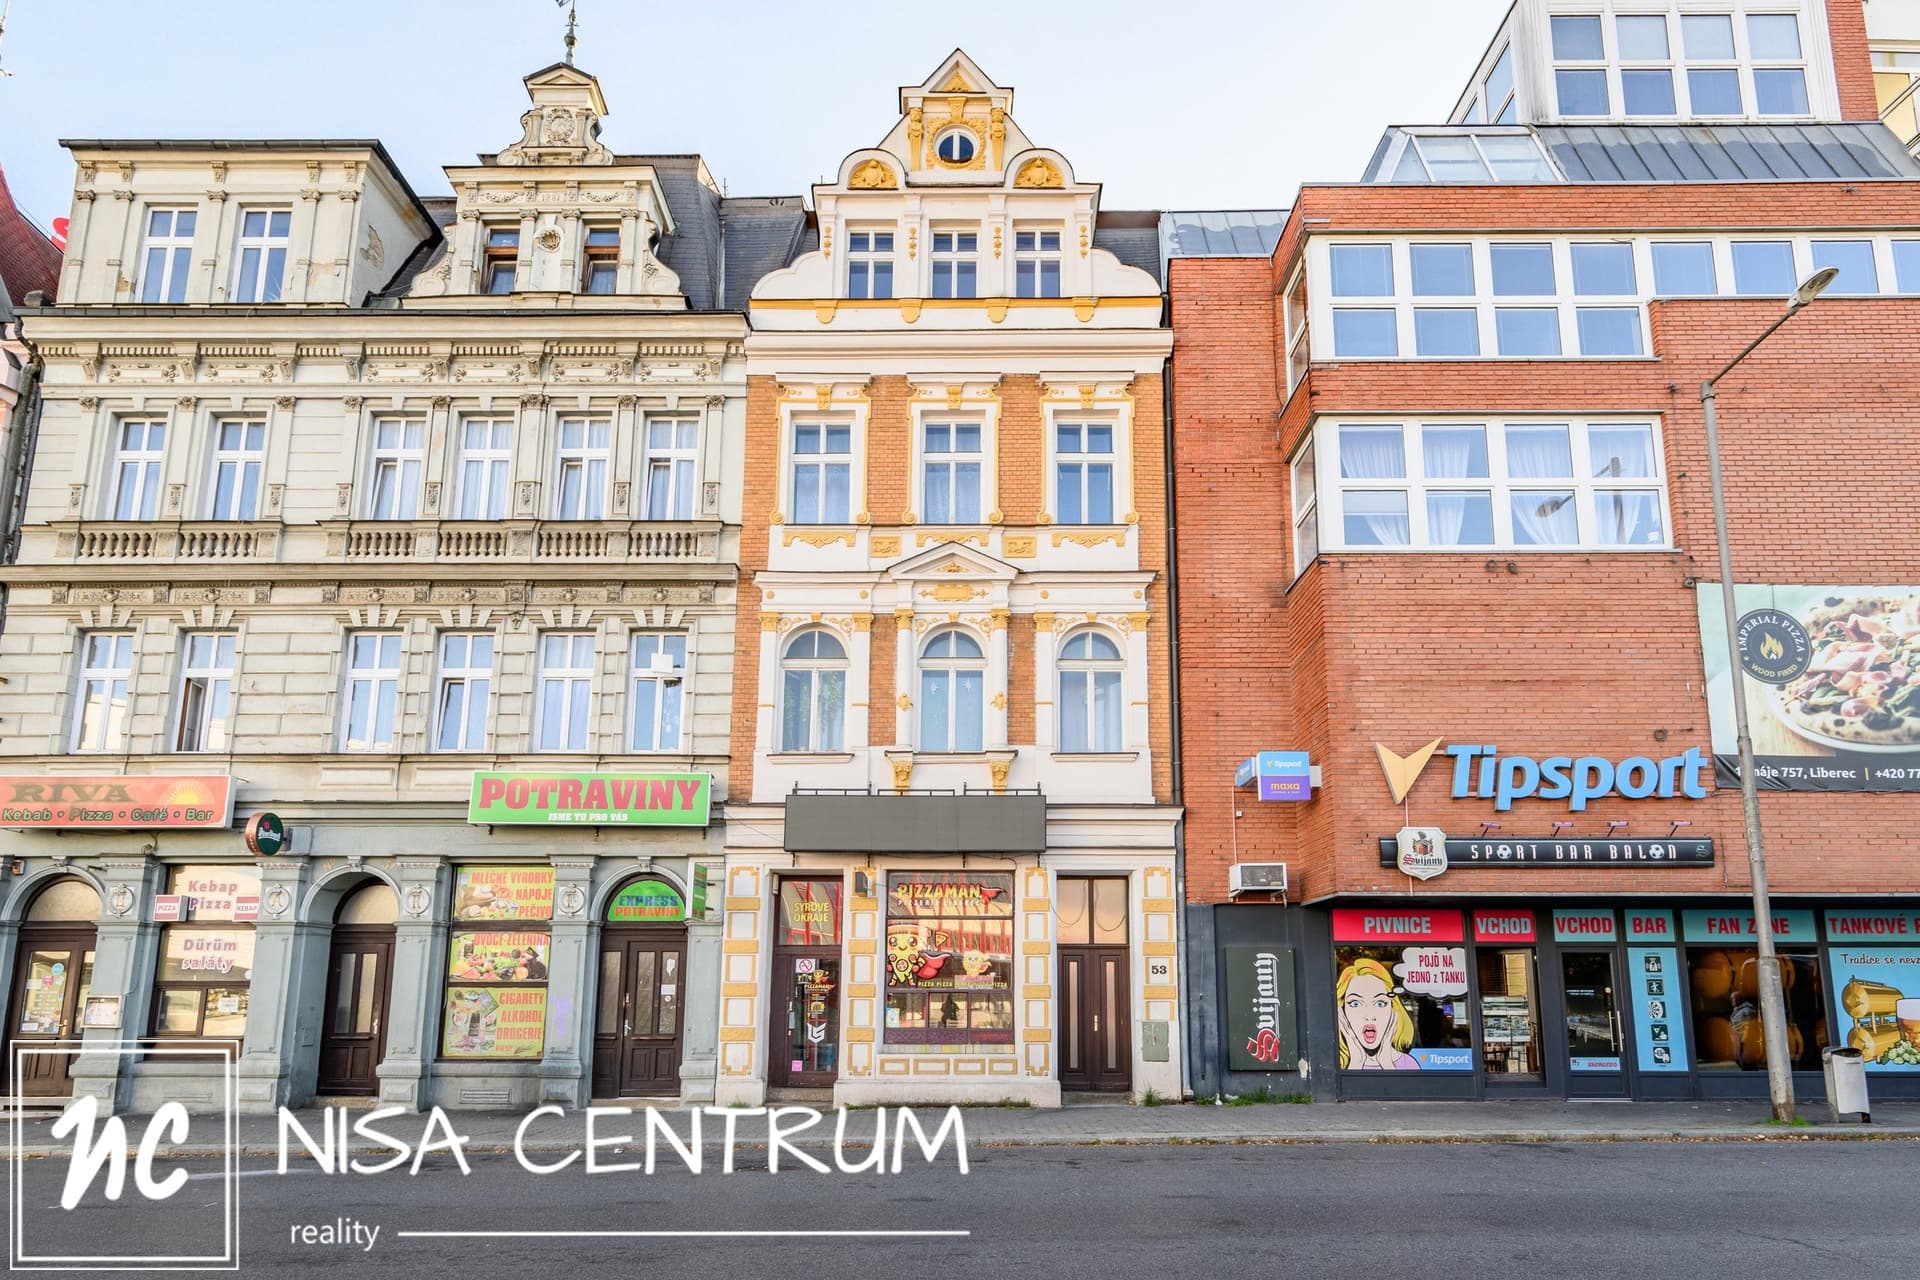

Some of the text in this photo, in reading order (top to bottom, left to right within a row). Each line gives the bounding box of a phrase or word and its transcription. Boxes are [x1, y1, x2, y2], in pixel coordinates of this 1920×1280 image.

[1738, 616, 1806, 653] IMPERIAL PIZZA
[1751, 663, 1797, 677] WOOD FIRED
[1446, 745, 1708, 812] Tipsport
[1781, 768, 1808, 779] 757,
[1810, 767, 1856, 779] Liberec
[1874, 768, 1905, 779] +420
[9, 784, 136, 803] RIVA
[479, 778, 701, 810] POTRAVINY
[2, 807, 214, 821] Kebab Pizza Café Bar
[549, 813, 572, 821] JSME
[574, 813, 587, 821] TU
[589, 813, 608, 821] PRO
[1556, 844, 1593, 860] BAR
[1402, 853, 1443, 866] Svijany
[188, 880, 238, 896] Kebap
[516, 887, 553, 900] NÁPOJE
[897, 883, 981, 898] PIZZAMAN
[188, 897, 231, 910] Pizza
[619, 895, 678, 906] EXPRESS
[518, 904, 552, 918] PEČIVO
[615, 907, 680, 917] POTRAVINY
[794, 912, 829, 922] OKRAJE
[1364, 917, 1432, 934] PIVNICE
[1476, 917, 1531, 935] VCHOD
[1555, 917, 1613, 934] VCHOD
[1632, 917, 1667, 934] BAR
[1706, 917, 1790, 934] FAN ZNE
[1829, 912, 1908, 934] TANKOVÉ
[183, 939, 237, 951] Dürüm
[181, 956, 234, 974] saláty
[1442, 954, 1454, 967] NA
[1840, 953, 1881, 965] Tradice
[1151, 965, 1167, 975] 53
[1406, 971, 1431, 984] JEDNO
[1441, 971, 1465, 984] TANKU
[499, 992, 545, 1005] CIGARETY
[1246, 952, 1281, 1063] Svijany
[501, 1010, 542, 1023] ALKOHOL
[1430, 1054, 1469, 1065] Tipsport
